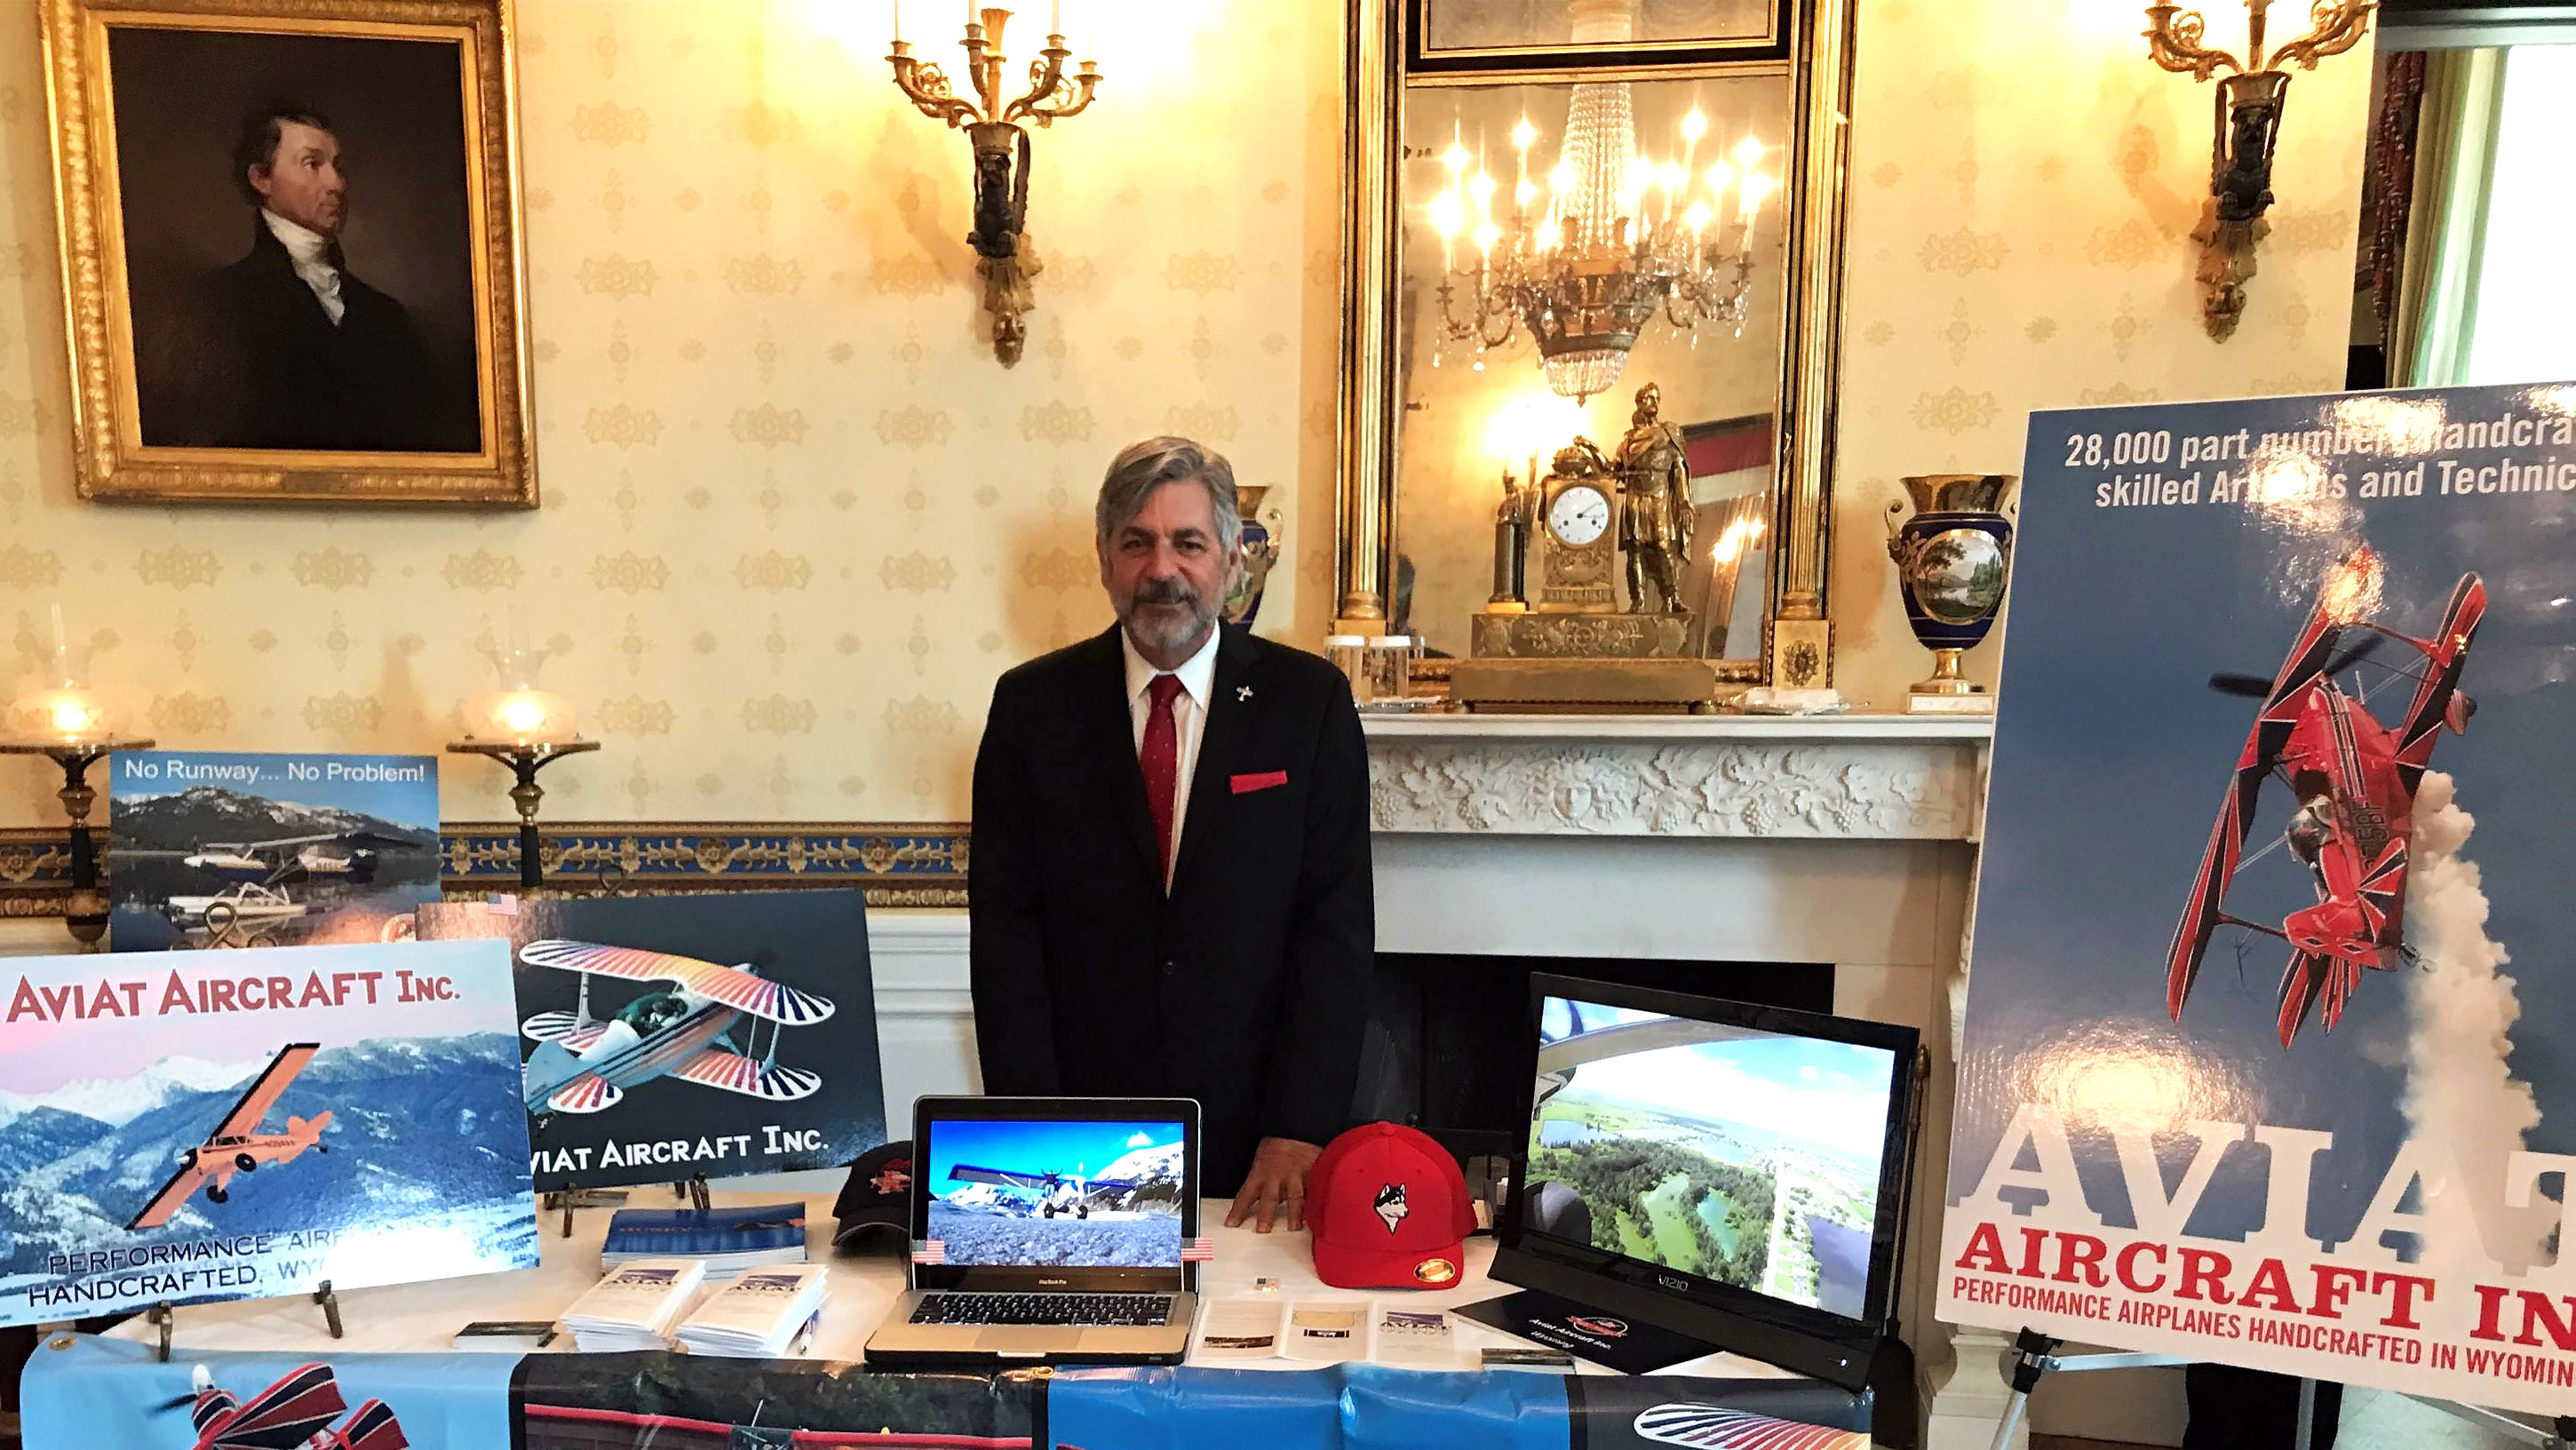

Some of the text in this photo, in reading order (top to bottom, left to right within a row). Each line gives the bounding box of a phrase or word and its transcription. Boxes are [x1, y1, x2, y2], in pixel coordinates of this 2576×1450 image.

[2065, 430, 2171, 470] 28,000
[2180, 428, 2250, 469] part
[2095, 472, 2201, 507] skilled
[2359, 461, 2425, 498] and
[124, 760, 425, 785] No Runway... No Problem!
[6, 975, 147, 1024] AVIAT
[158, 968, 383, 1016] AIRCRAFT
[599, 1135, 751, 1168] AIRCRAFT
[49, 1233, 273, 1275] PERFORMANCE
[1658, 1274, 1689, 1293] VIZIO
[1954, 1222, 2576, 1351] AIRCRAFT IN
[1952, 1276, 2112, 1321] PERFORMANCE
[2118, 1299, 2241, 1339] AIRPLANES
[2248, 1317, 2422, 1365] HANDCRAFTED
[2430, 1342, 2458, 1371] IN
